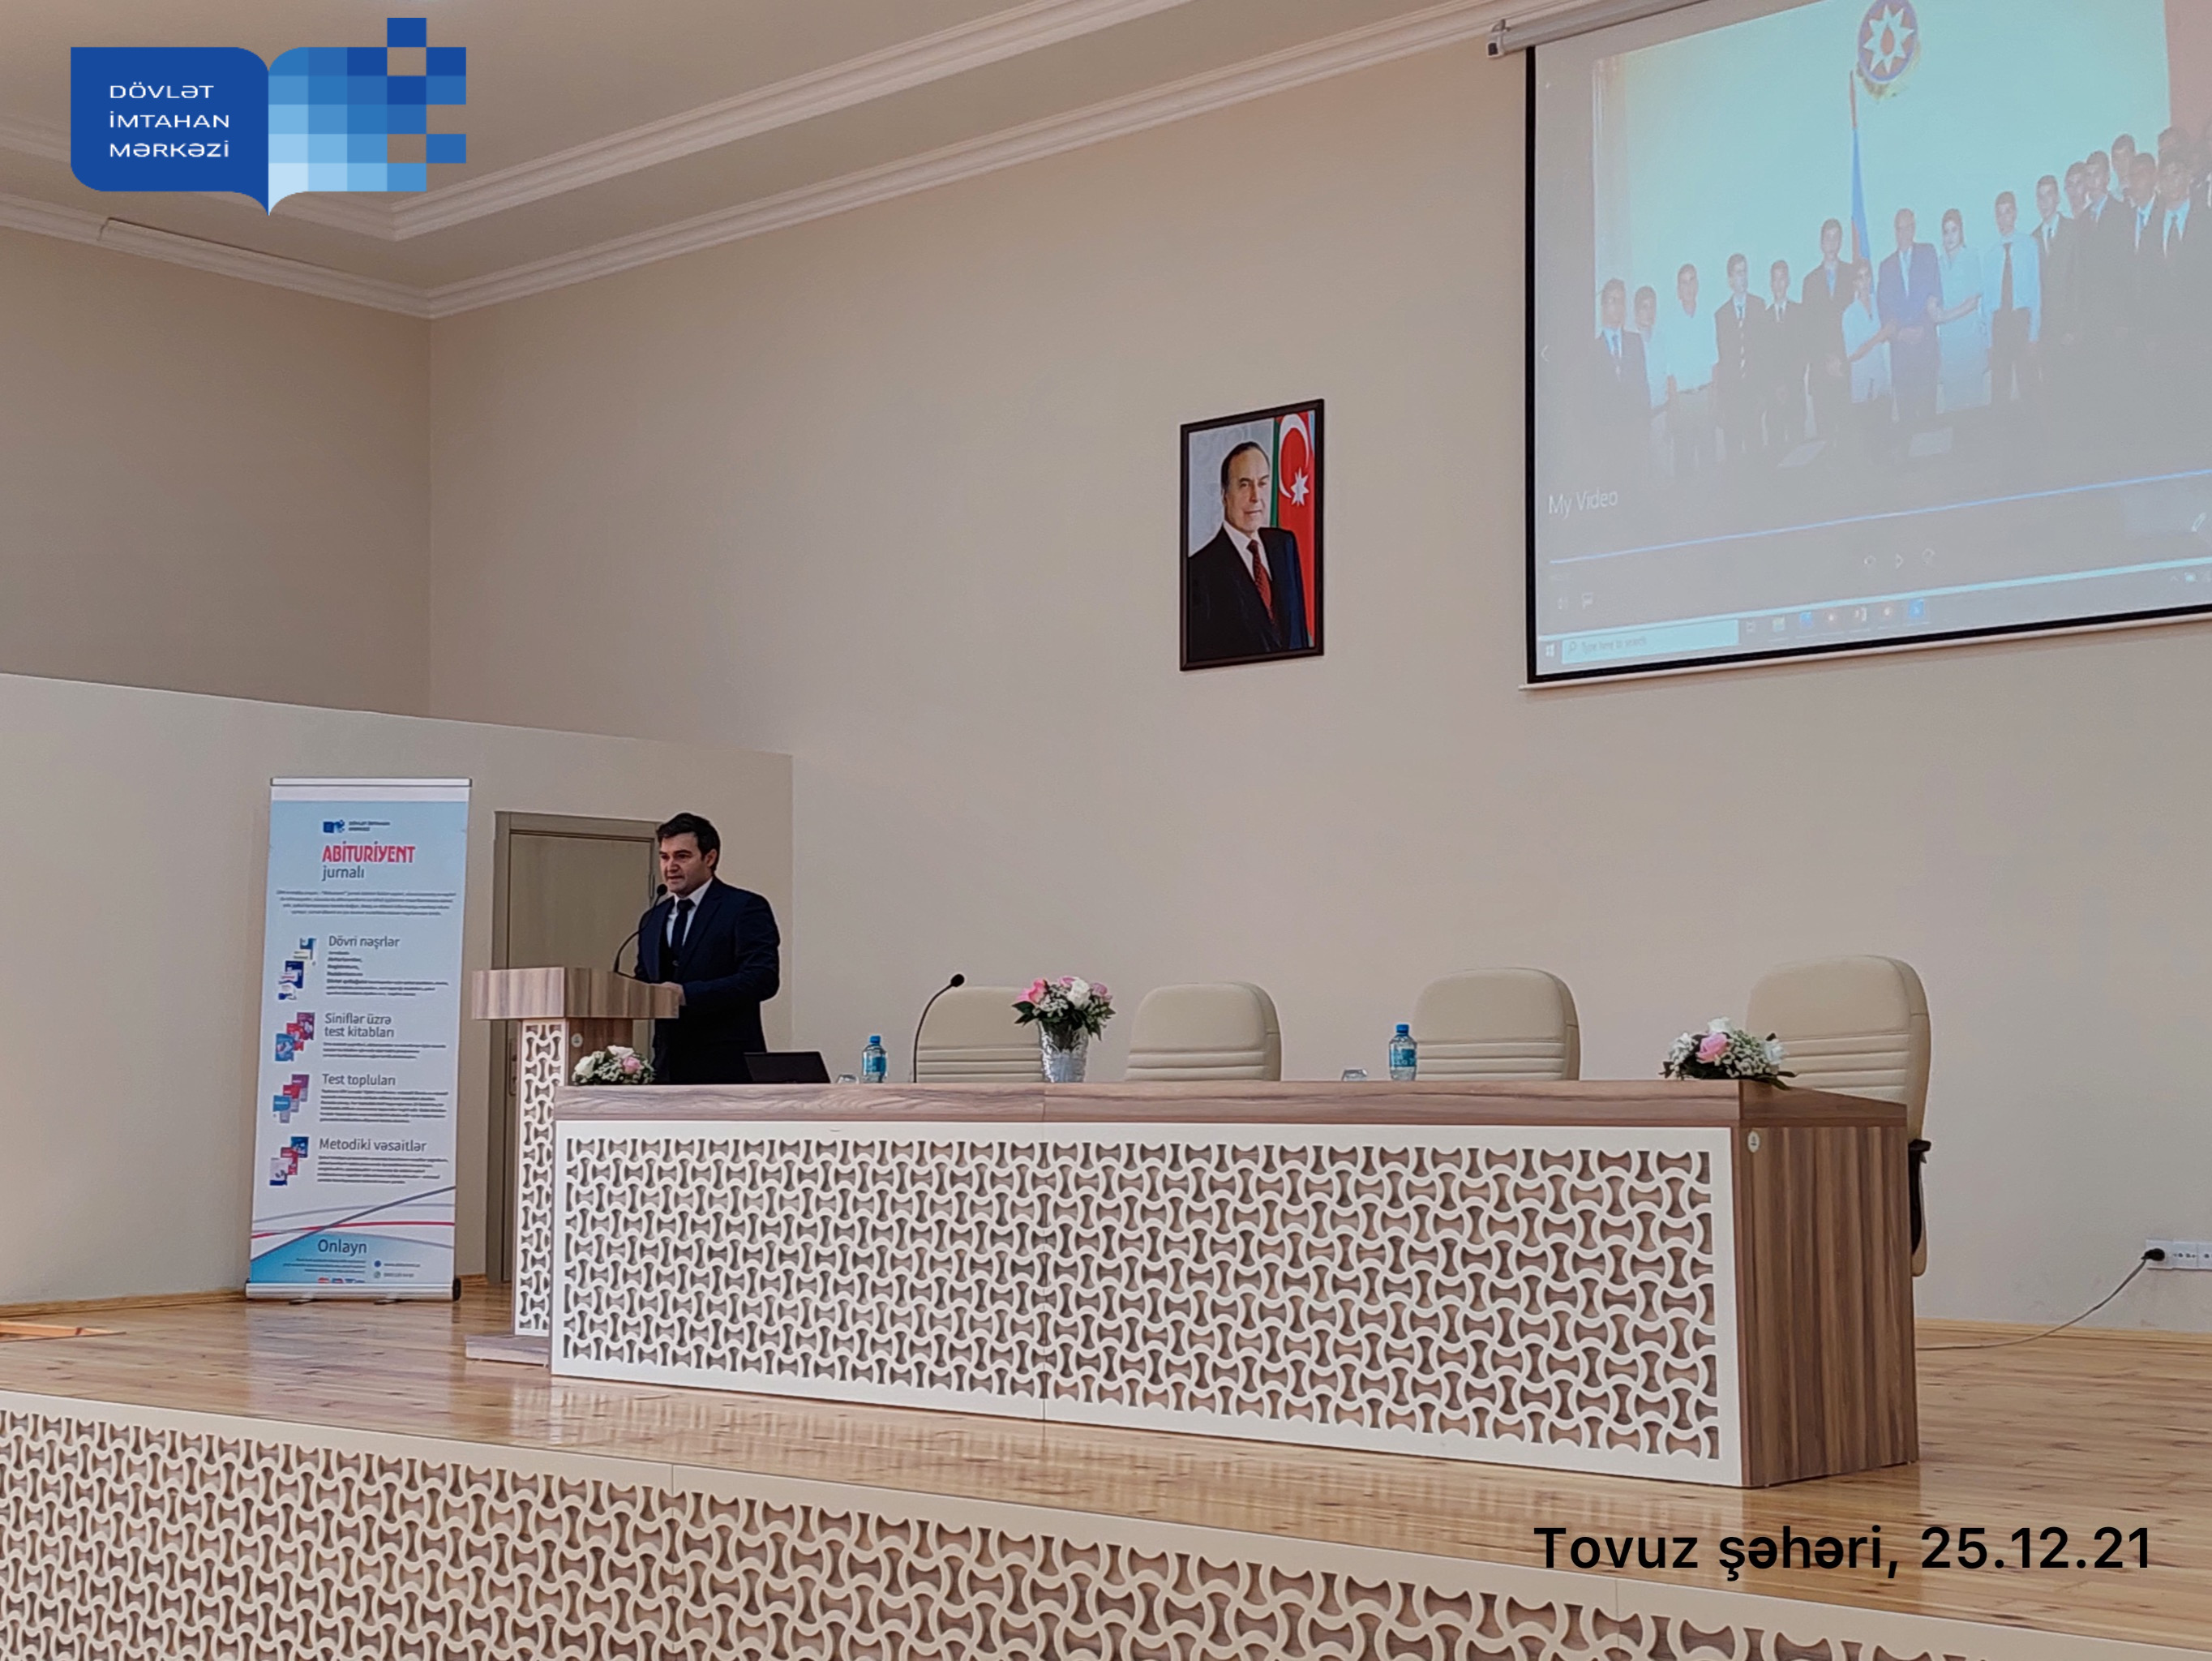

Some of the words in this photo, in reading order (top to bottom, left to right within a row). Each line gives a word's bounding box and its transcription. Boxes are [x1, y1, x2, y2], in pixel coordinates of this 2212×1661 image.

[1549, 494, 1572, 519] My
[1576, 487, 1618, 511] Video
[322, 840, 416, 863] ABİTURİYENT
[321, 865, 365, 882] jurnalı
[328, 934, 358, 947] Dövri
[359, 934, 401, 951] nəşrlər
[324, 1011, 366, 1024] Siniflər
[367, 1012, 392, 1025] üzrə
[324, 1026, 345, 1037] test
[347, 1025, 395, 1038] kitabları
[322, 1073, 345, 1085] Test
[347, 1073, 396, 1088] topluları
[319, 1138, 371, 1151] Metodiki
[373, 1140, 427, 1152] vəsaitlər
[317, 1238, 367, 1257] Onlayn
